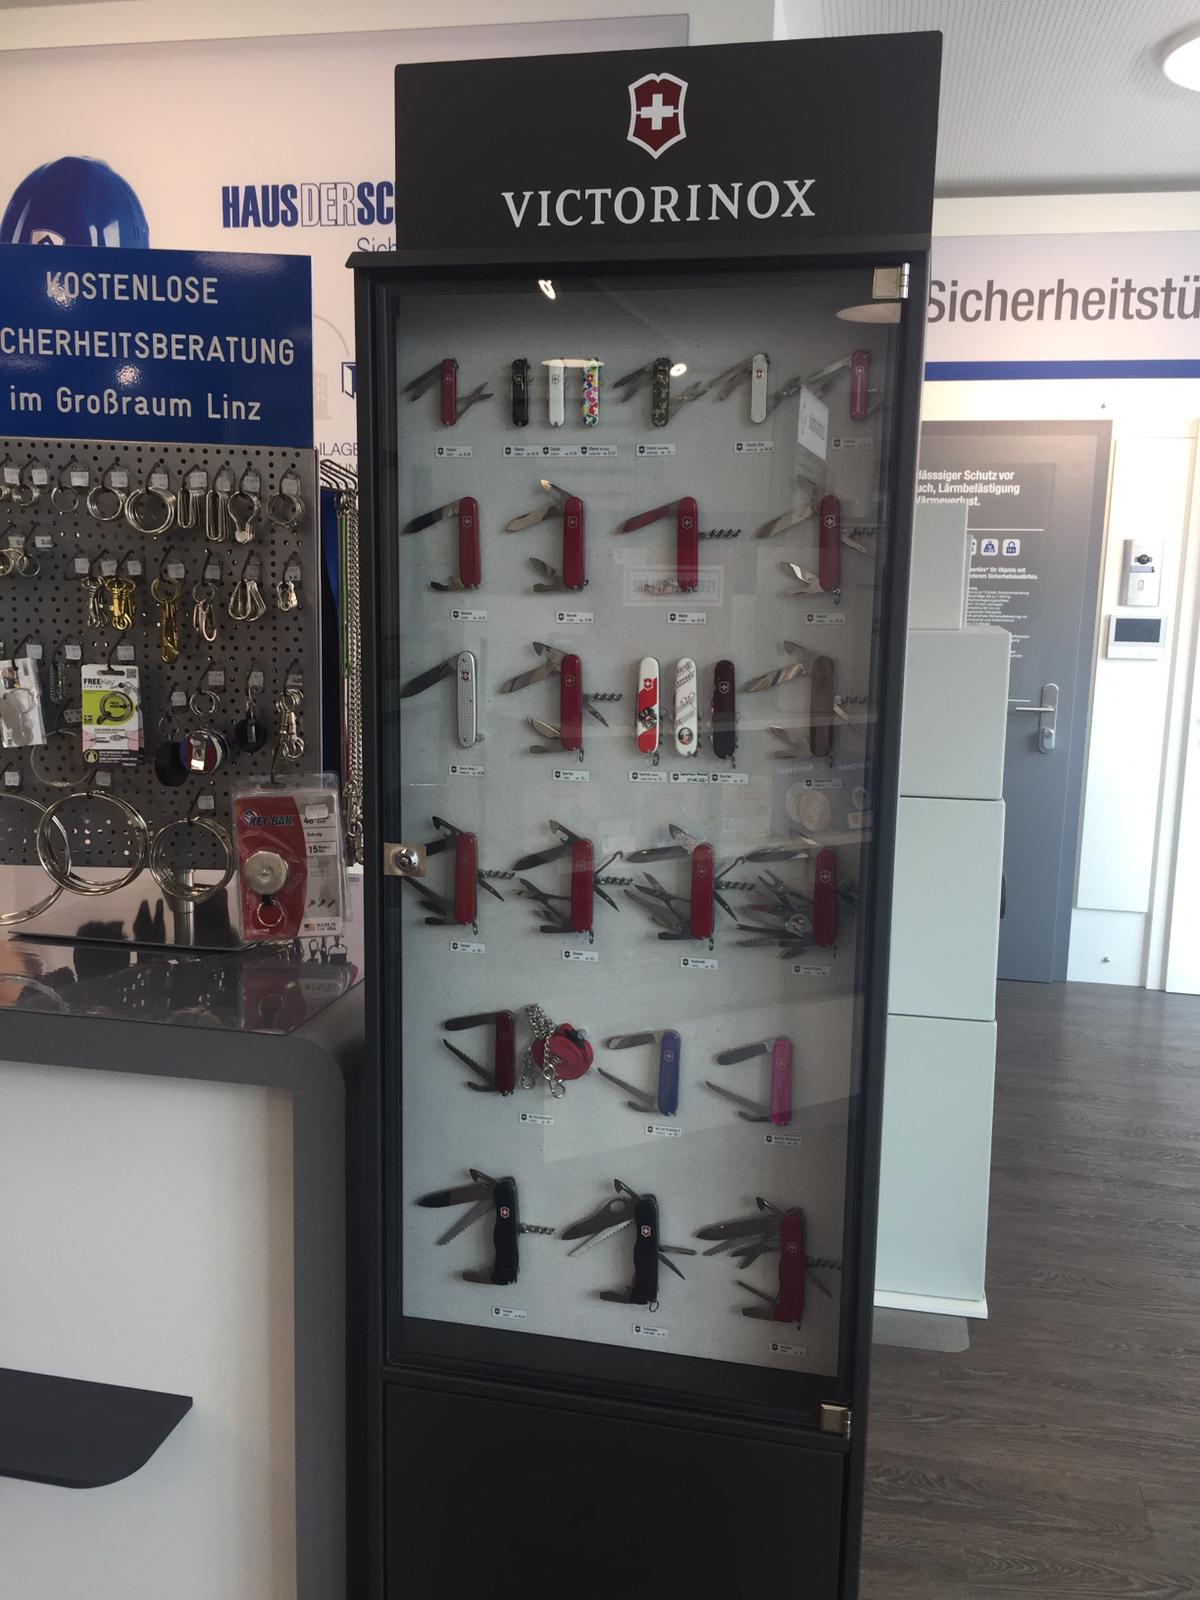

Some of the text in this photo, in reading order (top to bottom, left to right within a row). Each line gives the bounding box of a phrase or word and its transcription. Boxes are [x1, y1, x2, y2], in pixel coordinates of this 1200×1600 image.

[501, 179, 816, 228] VICTORINOX
[47, 271, 218, 304] KOSTENLOSE
[927, 274, 1200, 324] Sicherheitstü
[0, 327, 295, 366] CHERHEITSBERATUNG
[10, 385, 261, 421] im Großraum Linz
[938, 483, 1020, 496] Lärmbelästigung
[963, 469, 997, 481] Schutz
[999, 471, 1015, 480] vor
